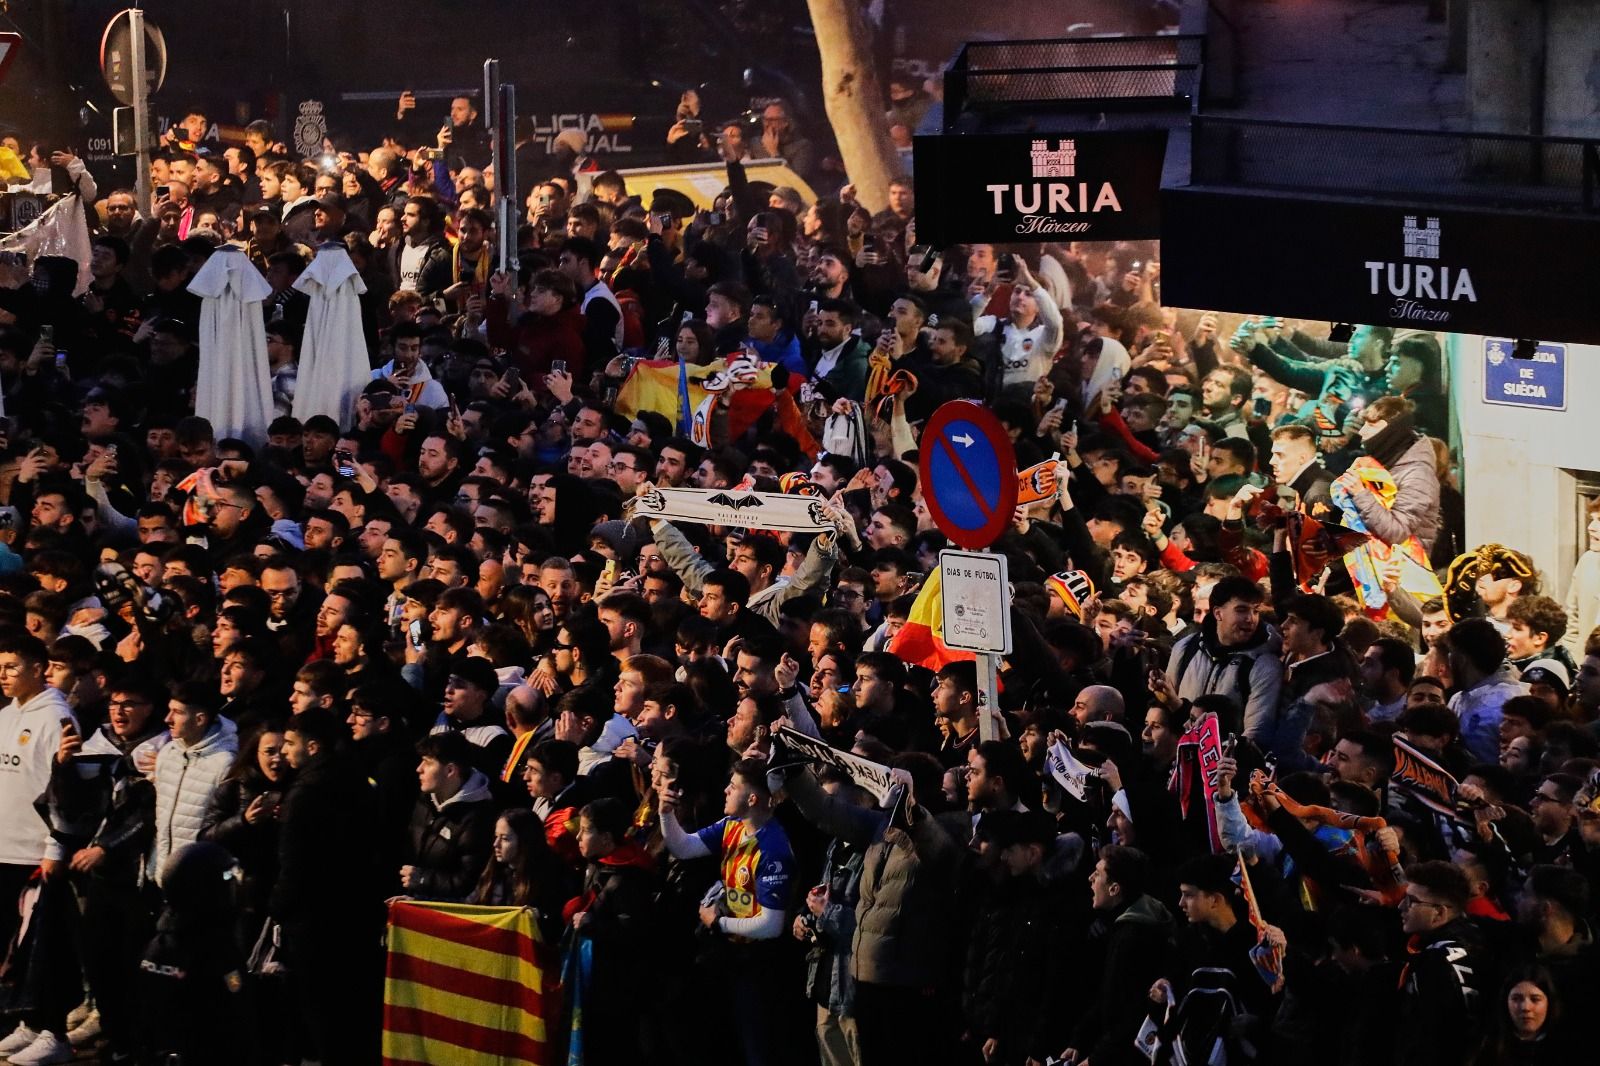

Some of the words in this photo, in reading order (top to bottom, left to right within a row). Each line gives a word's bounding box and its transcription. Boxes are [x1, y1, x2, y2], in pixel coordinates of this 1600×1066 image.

[986, 181, 1122, 215] TURIA
[1015, 215, 1092, 234] Märzen
[1364, 261, 1478, 302] TURIA
[1389, 297, 1452, 322] Märzen
[1519, 368, 1534, 379] DE
[1503, 380, 1547, 398] SUÈCIA
[964, 569, 972, 578] DE
